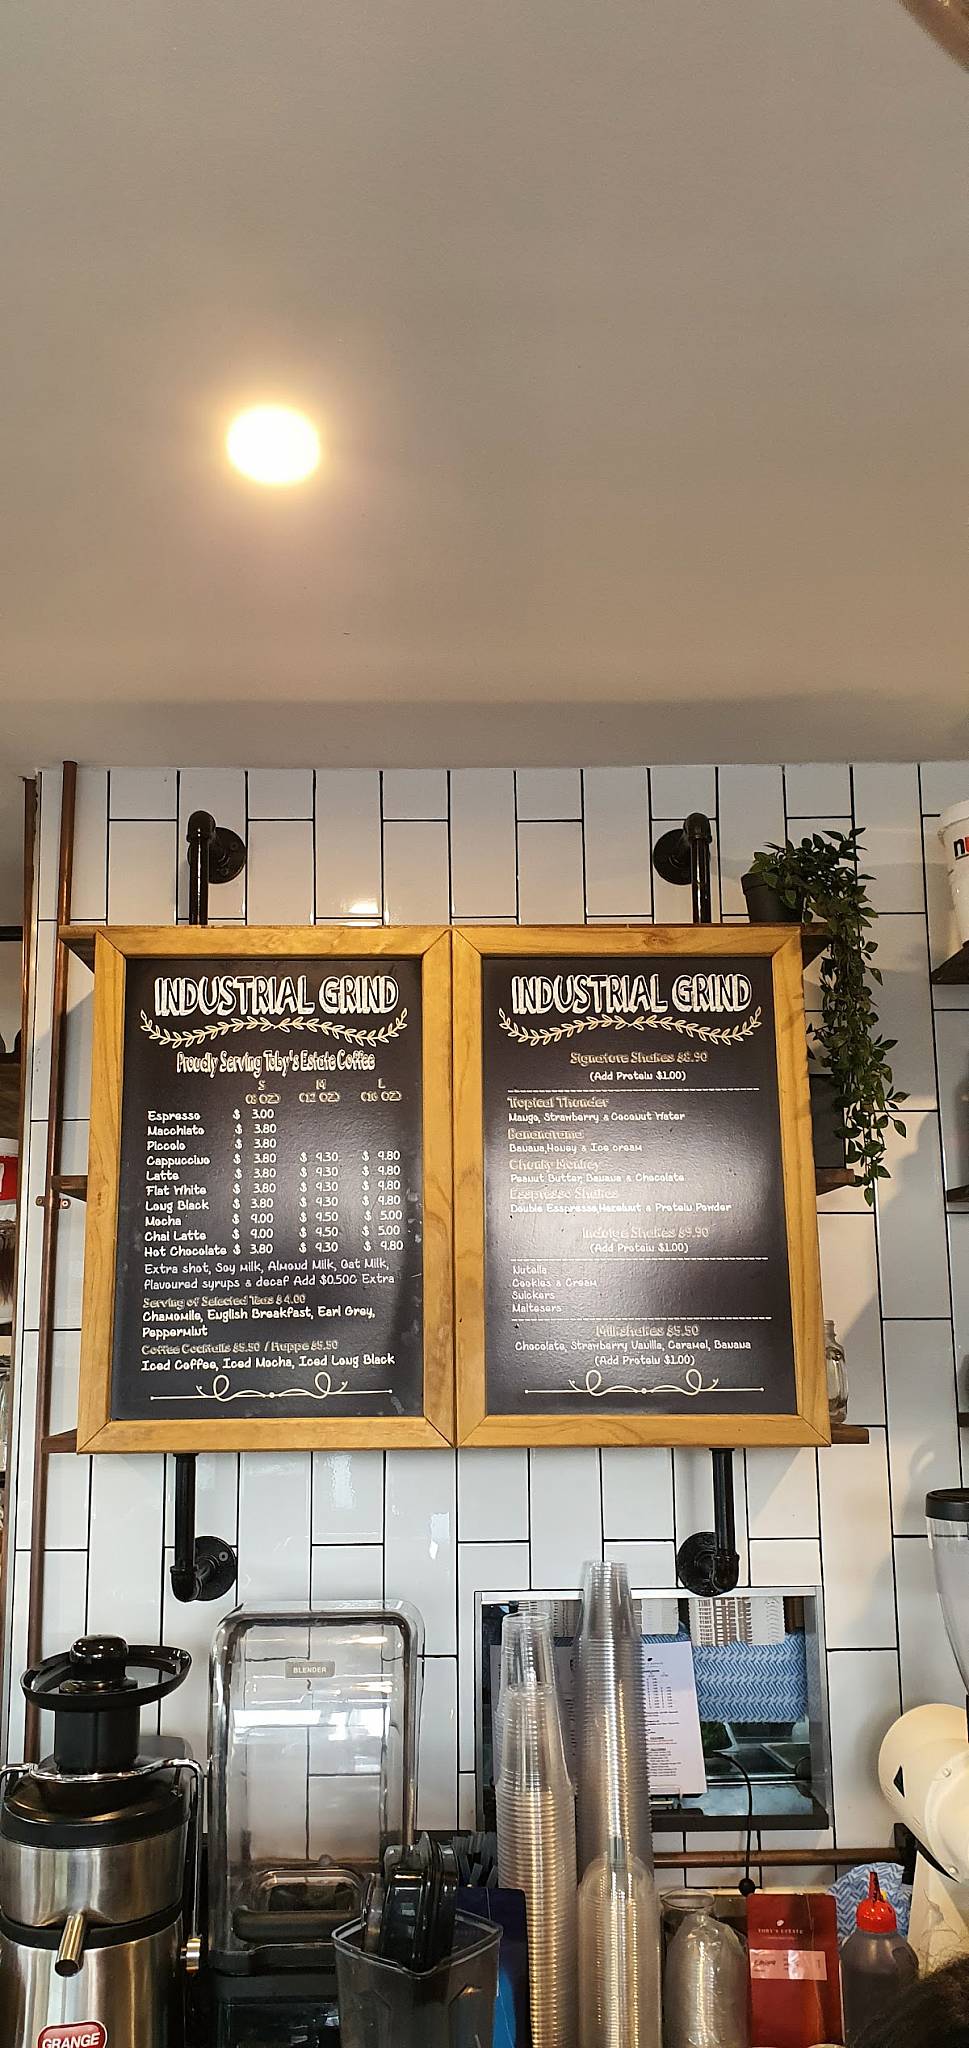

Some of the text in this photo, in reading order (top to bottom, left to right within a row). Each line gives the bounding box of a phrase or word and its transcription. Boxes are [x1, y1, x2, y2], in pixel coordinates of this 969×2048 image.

[154, 974, 399, 1017] INDUSTRIAL GRIND
[511, 972, 752, 1014] INDUSTRIAL GRIND
[176, 1049, 376, 1079] Proudly Serving Toby's Estate Coffee
[569, 1051, 629, 1067] Signature
[589, 1070, 686, 1082] (Add Protein $1.00)
[257, 1079, 266, 1091] S
[377, 1077, 386, 1089] L
[506, 1095, 610, 1111] Tropical Thunder
[147, 1108, 274, 1124] Espresso 3.00
[508, 1112, 541, 1124] Mango,
[543, 1111, 599, 1124] Strawberry
[610, 1111, 653, 1121] Coconut
[654, 1110, 686, 1121] Water
[146, 1123, 277, 1136] Macchiato 3.80
[146, 1137, 277, 1151] Piccolo 3.80
[590, 1143, 610, 1152] Ice
[146, 1154, 210, 1168] Cappuccino
[253, 1152, 276, 1164] 3.80
[145, 1169, 180, 1181] Latte
[253, 1167, 276, 1178] 3.80
[510, 1173, 544, 1182] Peanut
[585, 1172, 621, 1182] Banana
[635, 1172, 685, 1182] Chocolate
[145, 1184, 170, 1196] Flat
[172, 1183, 207, 1195] White
[252, 1182, 276, 1193] 3.80
[144, 1200, 174, 1214] Long
[176, 1198, 210, 1210] Black
[250, 1197, 274, 1209] 3.80
[509, 1203, 543, 1213] Double
[654, 1203, 693, 1213] Protein
[695, 1203, 732, 1213] Powder
[144, 1214, 182, 1226] Mocha
[379, 1209, 403, 1224] 5.00
[144, 1230, 170, 1242] Chai
[173, 1229, 207, 1241] Latte
[377, 1224, 400, 1236] 5.00
[143, 1245, 166, 1257] Hot
[169, 1244, 227, 1256] Chocolate
[249, 1243, 273, 1254] 3.80
[589, 1242, 691, 1254] (Add Protein $1.00)
[144, 1262, 178, 1274] Extra
[181, 1261, 212, 1275] shot,
[214, 1261, 236, 1275] Soy
[267, 1259, 308, 1271] Almond
[311, 1258, 337, 1272] Milk,
[364, 1257, 389, 1271] Milk,
[512, 1264, 548, 1275] Nutella
[143, 1277, 198, 1289] flavoured
[201, 1279, 240, 1291] syrups
[255, 1275, 290, 1287] decaf
[292, 1274, 316, 1286] Add
[361, 1272, 395, 1284] Extra
[511, 1278, 552, 1288] Cookies
[565, 1277, 597, 1287] Cream
[142, 1296, 185, 1310] Serving
[185, 1296, 200, 1307] of
[200, 1295, 248, 1306] Selected
[248, 1294, 274, 1305] Teas
[511, 1290, 555, 1301] Snickers
[142, 1305, 375, 1324] Chamomile, English Breakfast, Earl Grey,
[511, 1303, 562, 1313] Maltesers
[142, 1325, 208, 1340] Peppermint
[140, 1344, 180, 1355] Coffee
[514, 1339, 751, 1353] Chocolate, Strawberry Vanilla, Caramel, Banana
[140, 1353, 395, 1372] Iced Coffee, Iced Mocha, Iced Long Black
[593, 1353, 696, 1367] (Add Protein $1.00)
[293, 1666, 327, 1674] BLENDER
[42, 2031, 101, 2048] GRANGE
